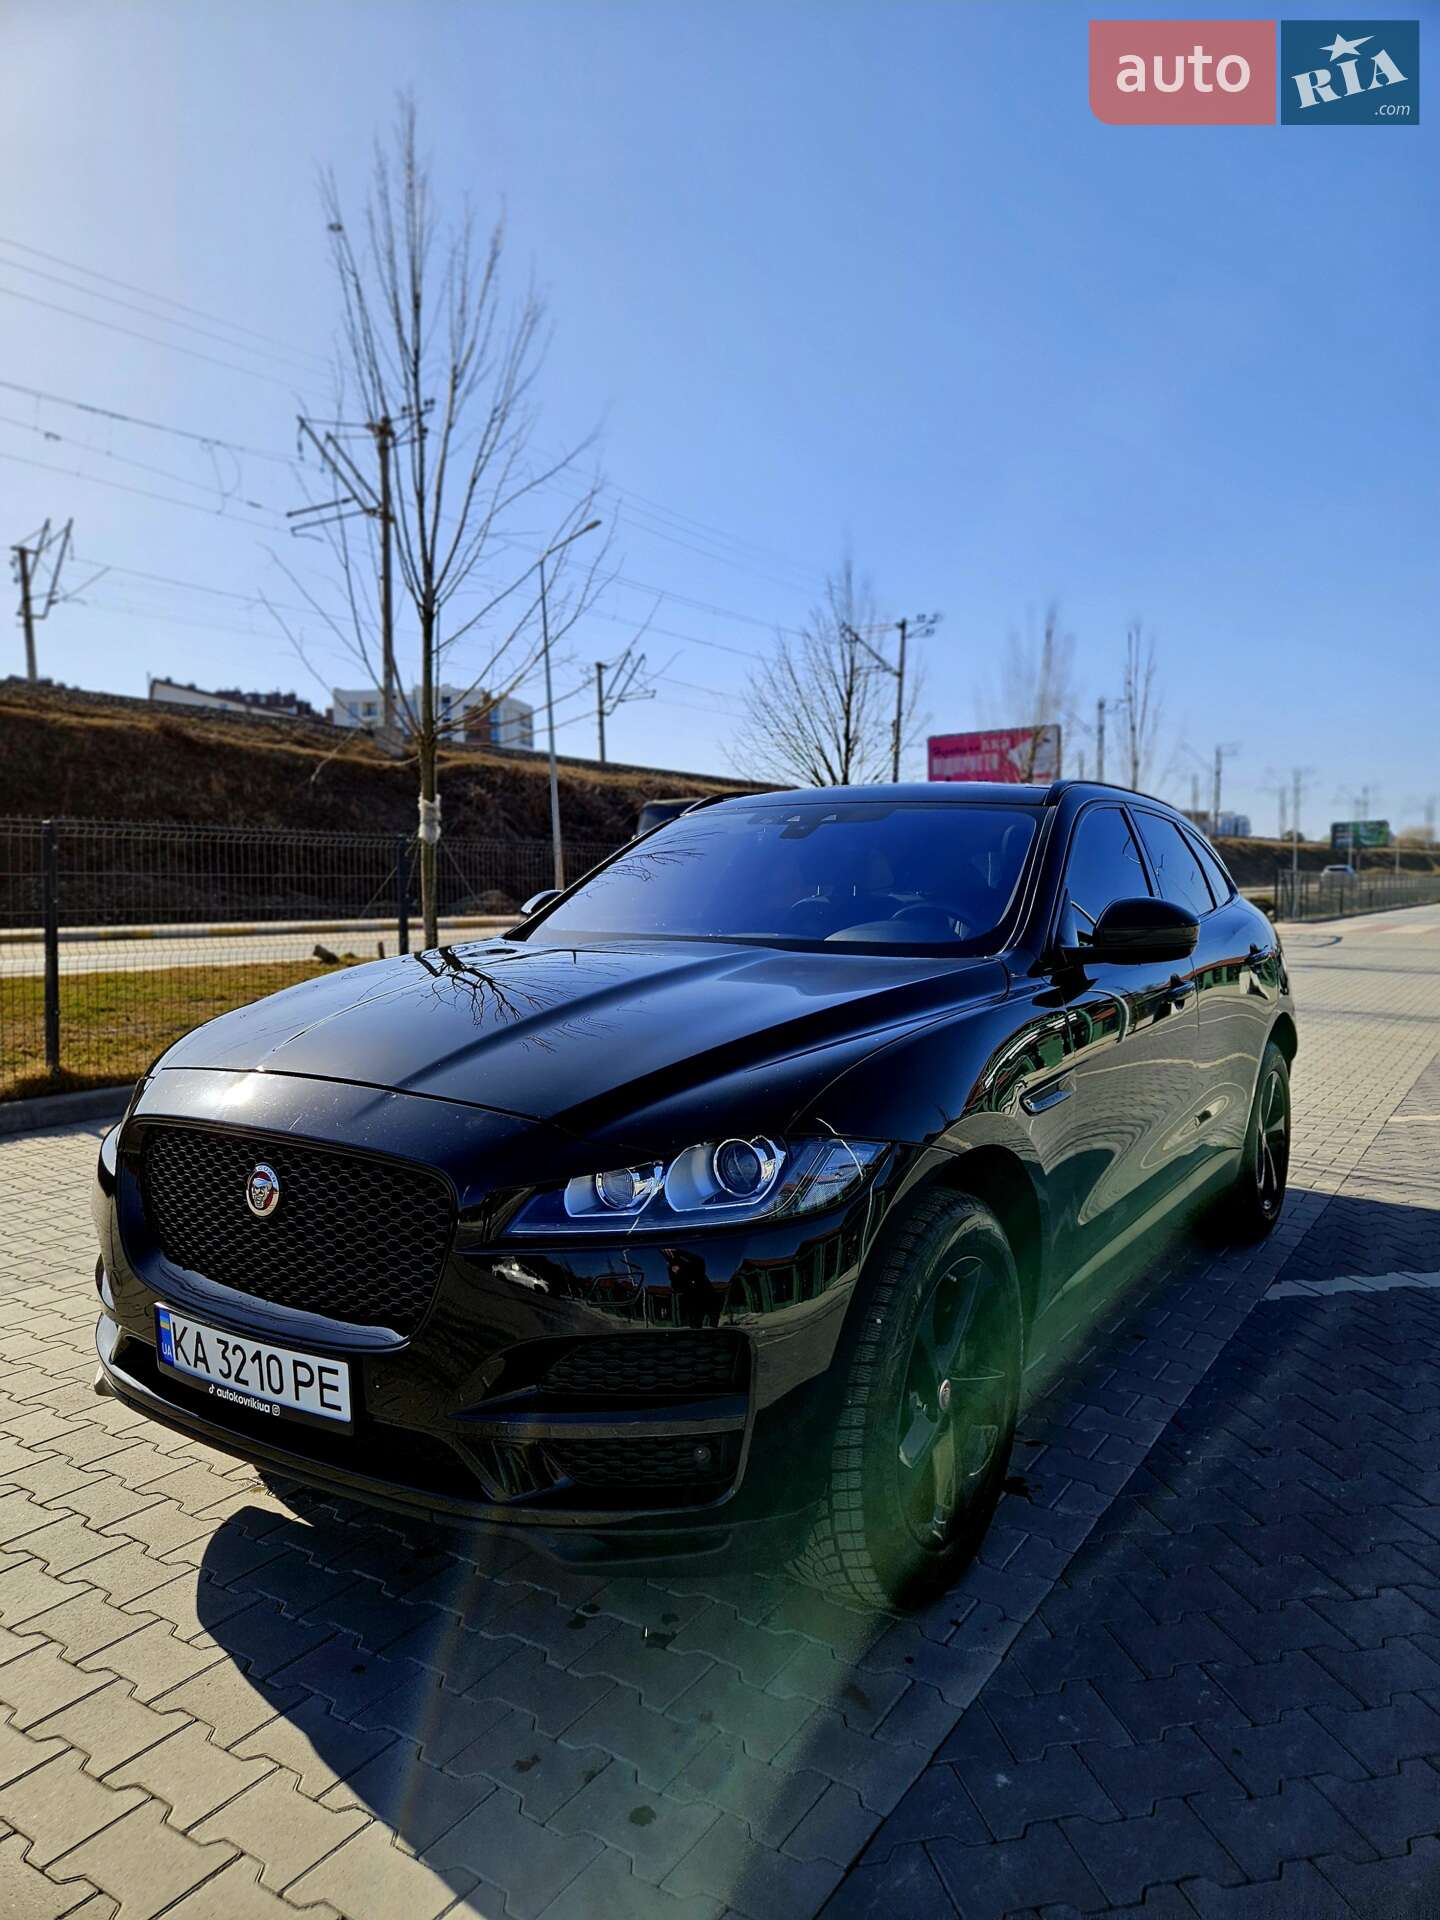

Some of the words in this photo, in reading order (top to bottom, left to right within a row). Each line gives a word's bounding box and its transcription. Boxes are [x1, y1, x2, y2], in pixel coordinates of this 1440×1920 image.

[161, 1342, 172, 1357] UA
[172, 1321, 211, 1374] KA
[216, 1338, 284, 1394] 3210
[292, 1359, 342, 1411] PE
